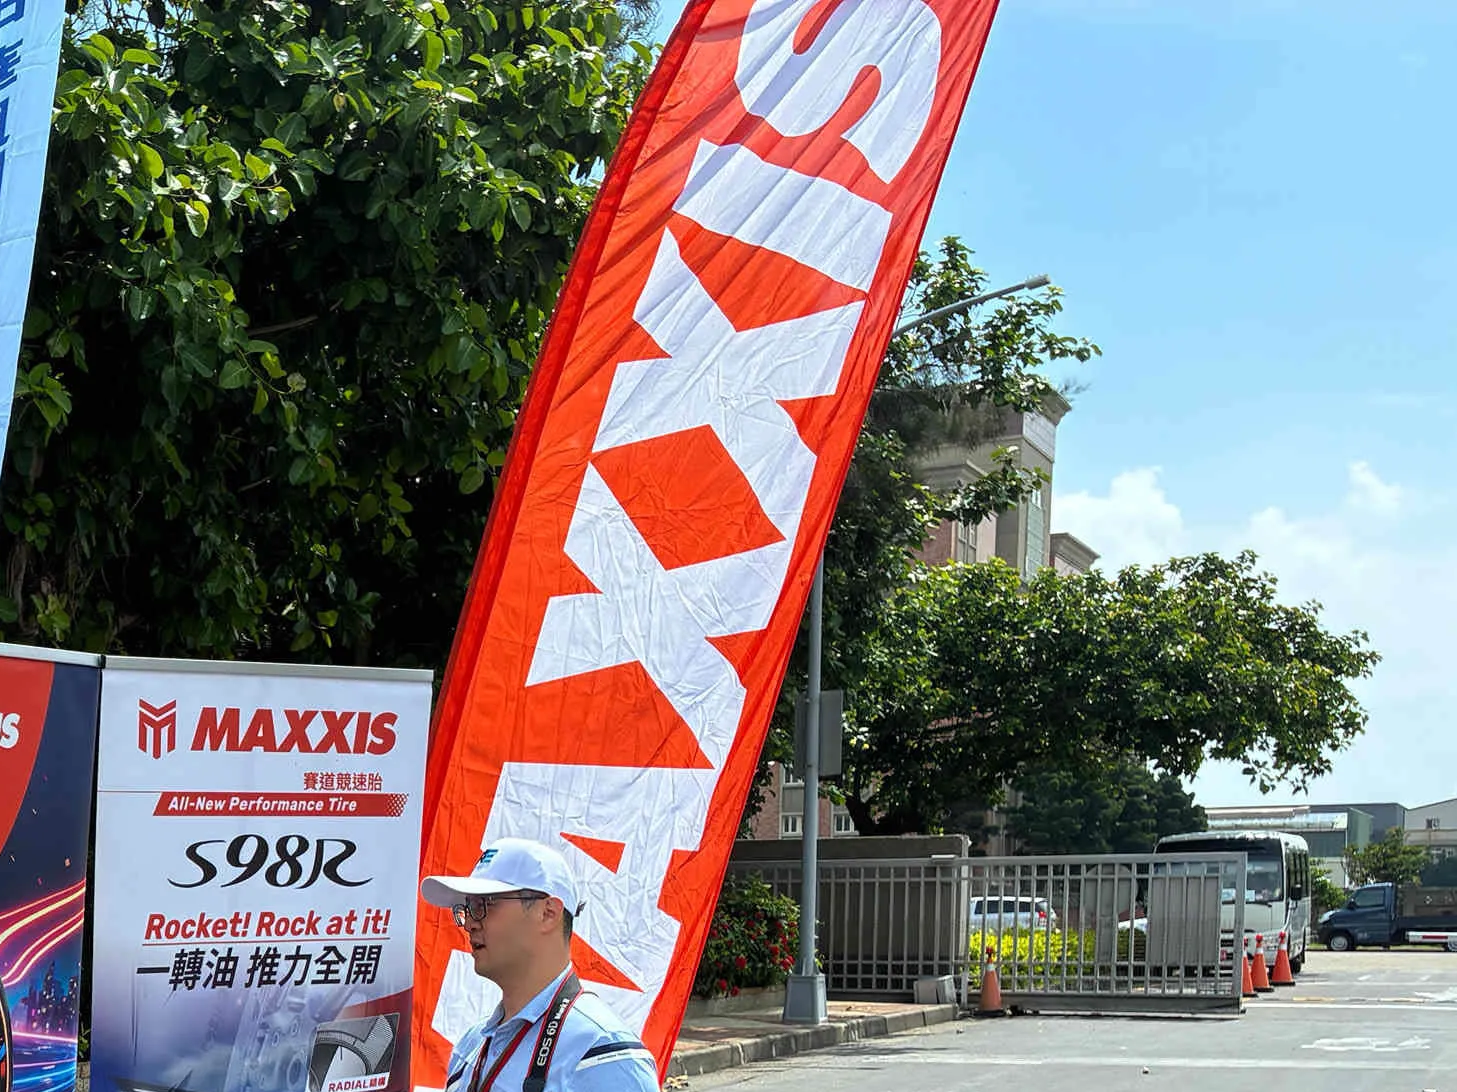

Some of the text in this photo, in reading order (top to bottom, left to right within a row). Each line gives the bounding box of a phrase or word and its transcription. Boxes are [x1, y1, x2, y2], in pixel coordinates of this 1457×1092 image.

[191, 706, 399, 756] MAXXIS
[168, 796, 357, 812] All-New Performance Tire
[303, 772, 383, 791] 賽道競速胎
[167, 834, 374, 889] S98R
[144, 908, 391, 940] Rocket! Rock at it!
[136, 945, 383, 991] 一轉油 推力全開
[536, 1037, 553, 1066] EOS
[546, 1020, 558, 1036] 6D
